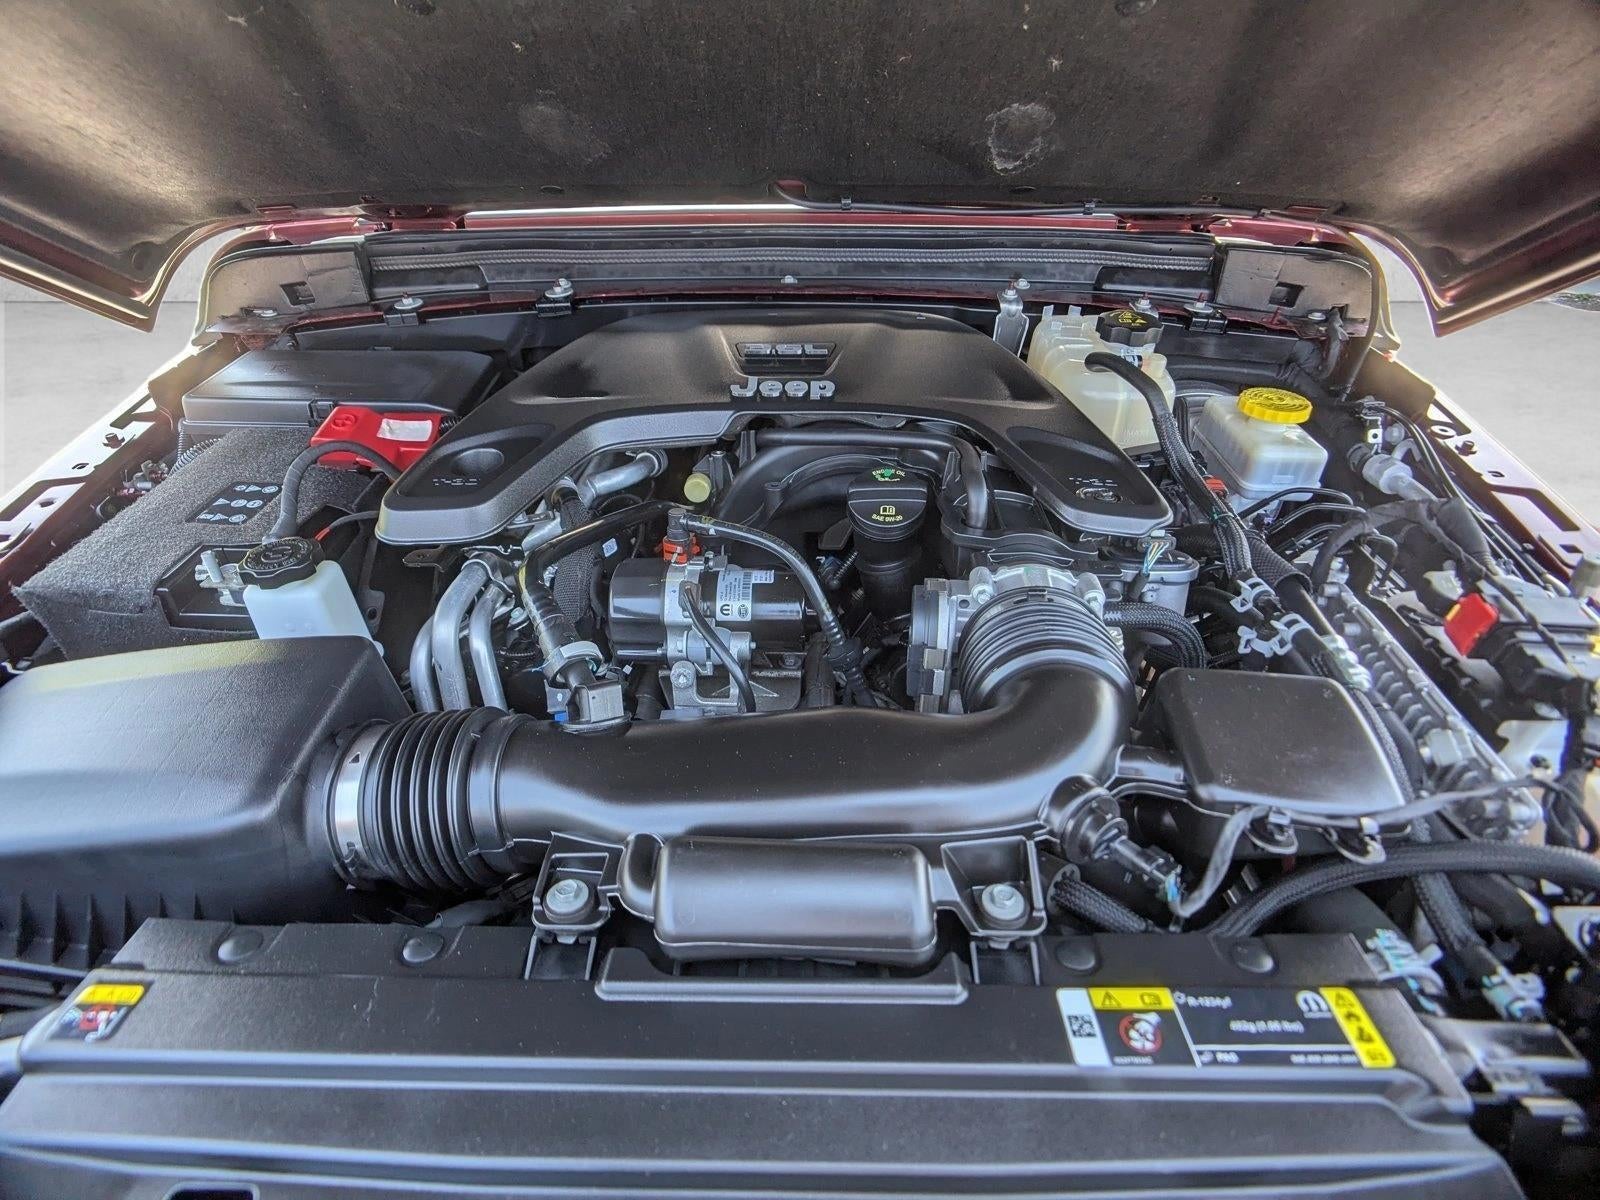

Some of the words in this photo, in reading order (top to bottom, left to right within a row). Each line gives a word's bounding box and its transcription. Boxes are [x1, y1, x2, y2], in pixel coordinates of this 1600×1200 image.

[730, 376, 836, 400] Jeep
[871, 468, 896, 476] ENGE
[871, 513, 885, 522] SAE
